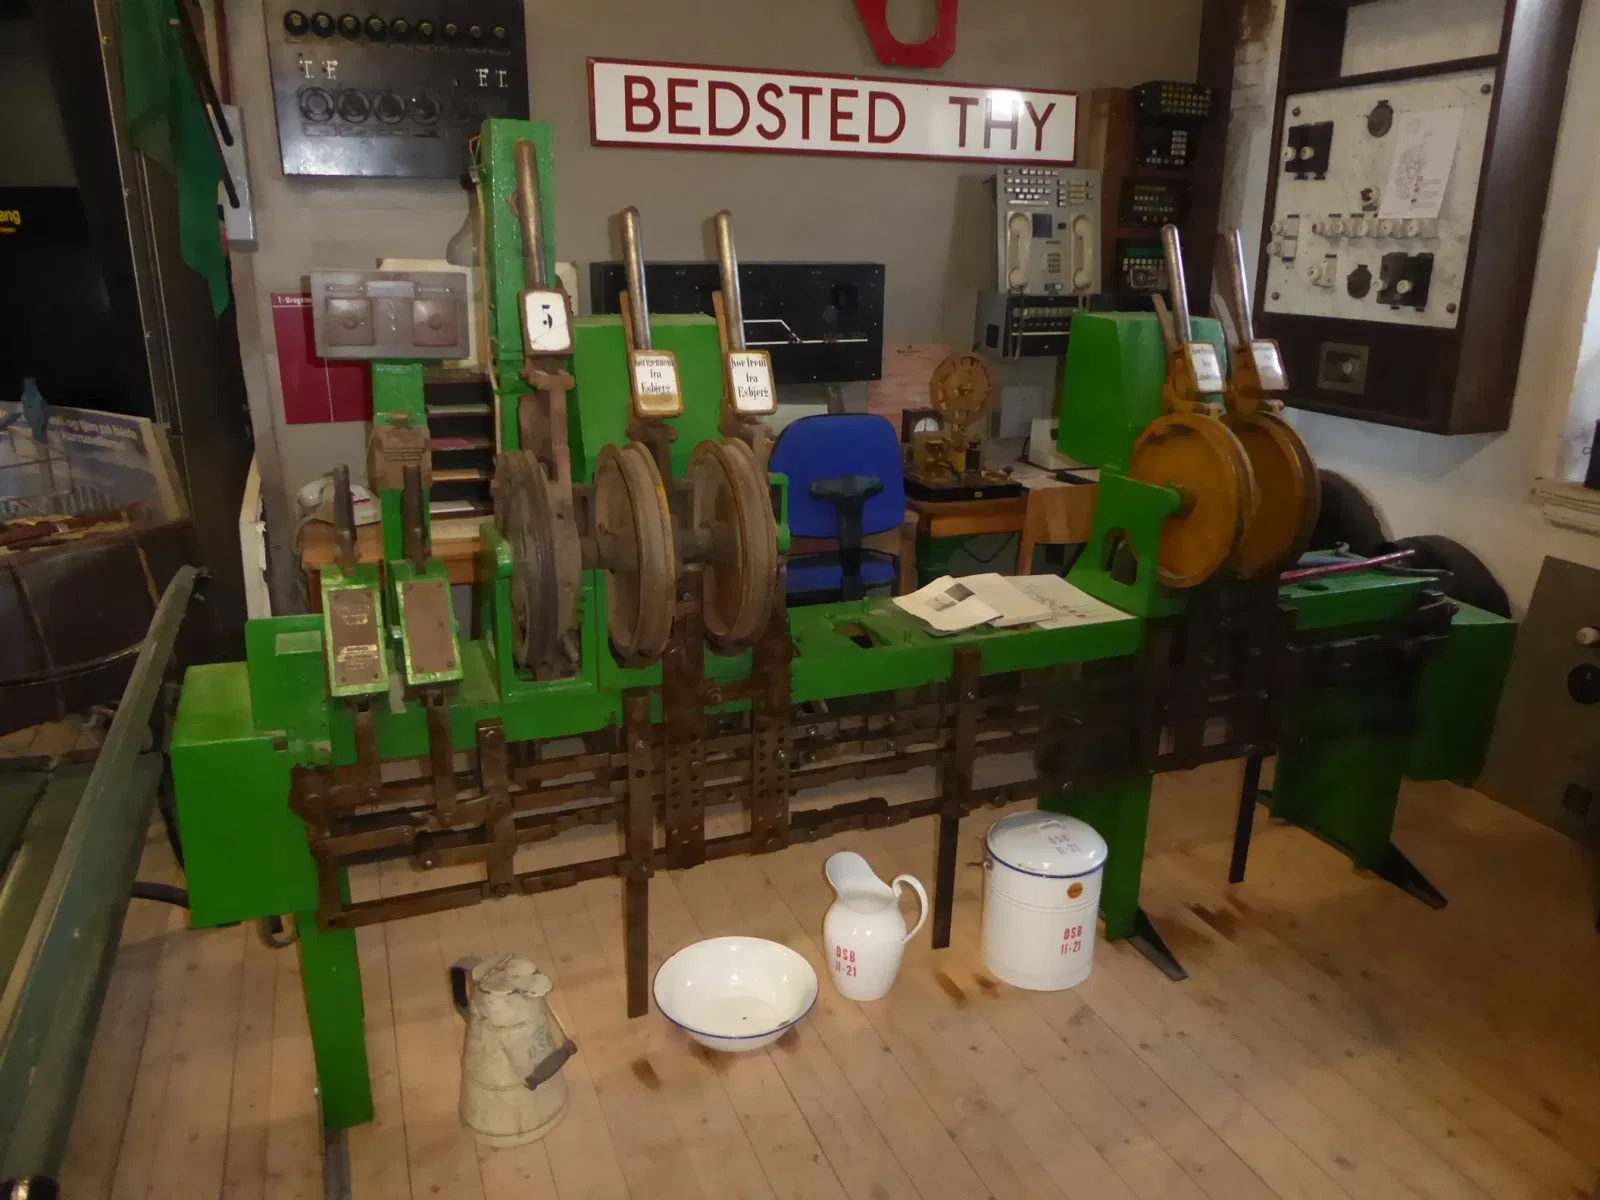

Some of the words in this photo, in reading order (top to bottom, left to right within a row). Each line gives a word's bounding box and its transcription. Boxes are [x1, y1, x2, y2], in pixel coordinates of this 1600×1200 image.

[624, 74, 906, 143] BEDSTED
[948, 96, 1056, 152] THY
[541, 304, 553, 329] 5
[650, 368, 662, 378] fra
[746, 372, 758, 383] fra
[641, 382, 671, 393] Esbjerg
[738, 386, 769, 400] Esbjerg
[1064, 925, 1083, 940] DSB
[836, 945, 856, 962] DSB
[1061, 941, 1082, 955] 11-21
[835, 960, 857, 977] 11-21
